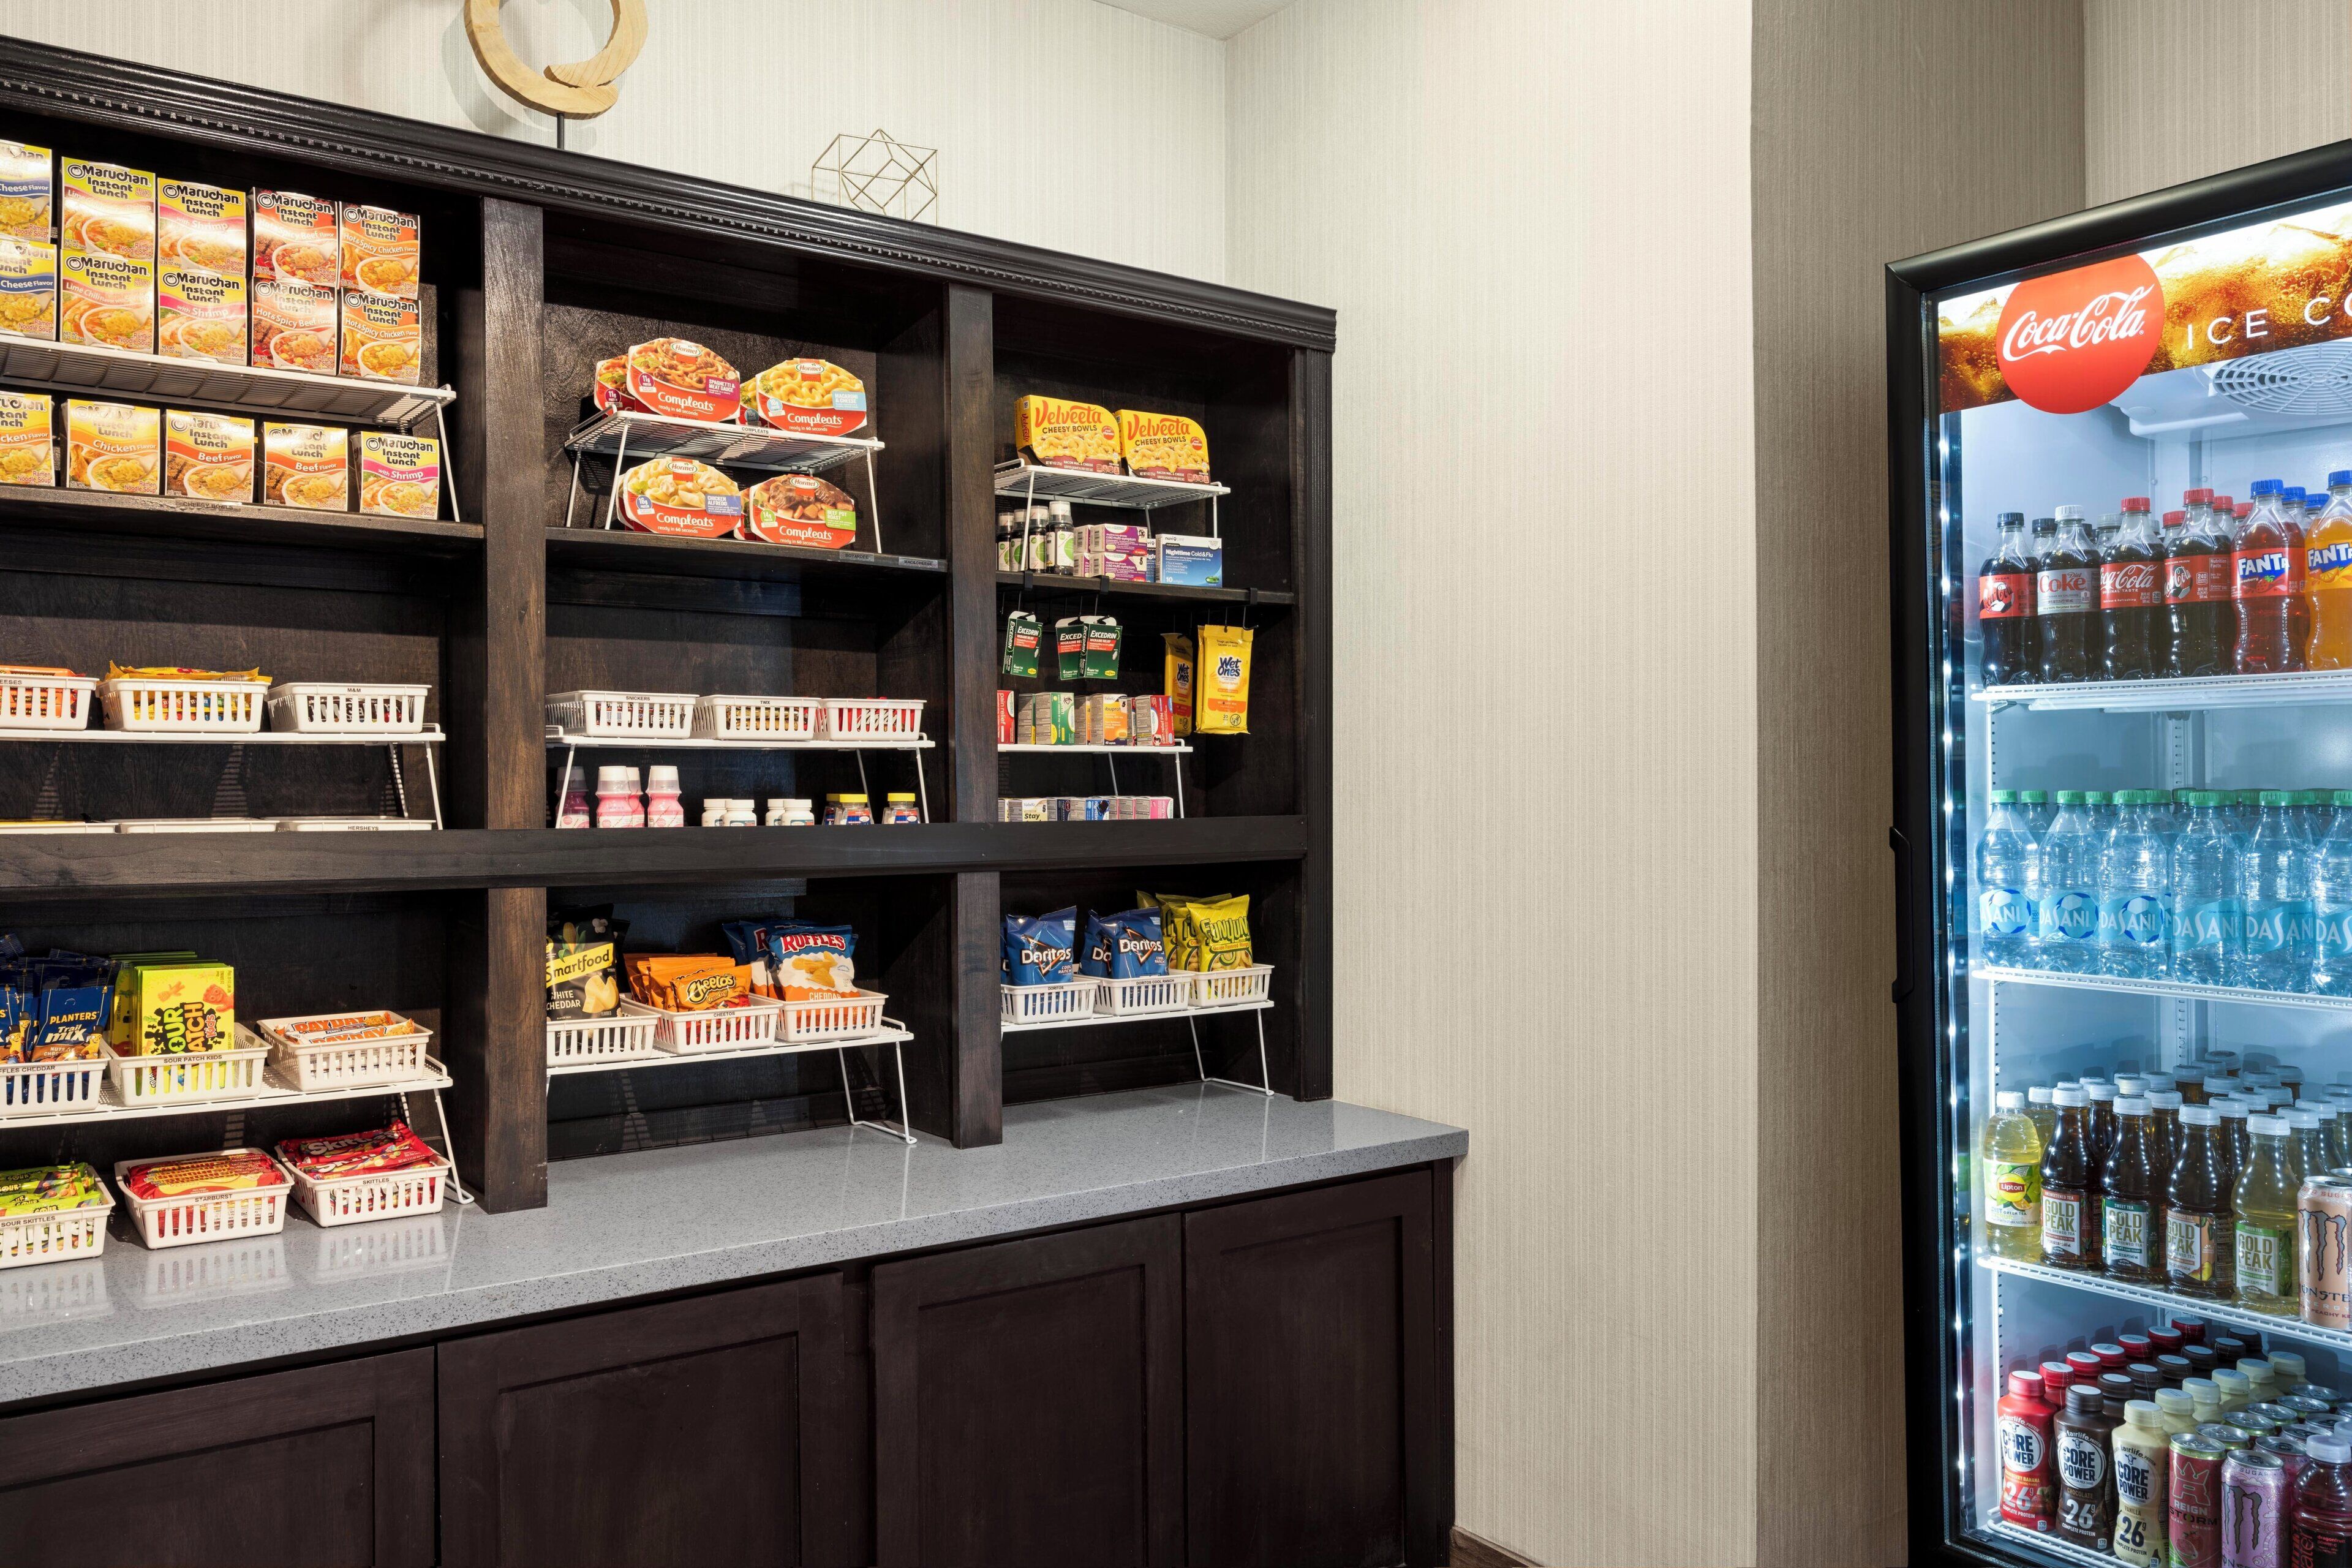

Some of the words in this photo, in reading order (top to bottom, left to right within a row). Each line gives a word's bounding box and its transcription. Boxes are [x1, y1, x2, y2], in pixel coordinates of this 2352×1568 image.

[81, 164, 149, 186] Maruchan
[88, 176, 132, 192] Instant
[92, 186, 128, 199] Lunch
[176, 184, 240, 205] Maruchan
[181, 197, 225, 211] Instant
[186, 205, 220, 217] Lunch
[80, 257, 147, 276] Maruchan
[86, 268, 132, 282] Instant
[176, 273, 240, 290] Maruchan
[91, 277, 127, 290] Lunch
[181, 284, 225, 296] Instant
[186, 292, 220, 304] Lunch
[192, 307, 229, 317] Shrimp
[2002, 284, 2155, 362] Coca-Cola
[2187, 309, 2269, 350] ICE
[674, 345, 698, 355] Hormel
[658, 392, 714, 411] Compleats
[788, 413, 842, 426] Compleats
[1035, 401, 1102, 428] Velveeta
[1128, 414, 1190, 440] Velveeta
[93, 440, 136, 453] Chicken
[198, 452, 222, 462] Beef
[295, 462, 318, 472] Beef
[391, 469, 423, 480] Shrimp
[656, 513, 714, 527] Compleats
[779, 526, 832, 540] Compleats
[2238, 552, 2290, 575] FANTA
[2040, 573, 2087, 594] Coke
[1017, 626, 1039, 636] EXCEDRIN
[1090, 630, 1117, 639] EXCEDRIN
[1178, 663, 1189, 674] Wet
[1219, 657, 1242, 668] Wet
[1177, 673, 1189, 683] Ones
[1218, 666, 1240, 677] Ones
[2040, 904, 2089, 932] DASANI
[2101, 908, 2155, 935] DASANI
[781, 934, 846, 954] RUFFLES
[1119, 939, 1163, 953] Doritos
[1022, 948, 1071, 963] Doritos
[546, 949, 609, 982] Smartfood
[551, 990, 573, 1000] WHITE
[687, 976, 735, 1003] Cheetos
[707, 990, 727, 1003] Crunchy
[546, 1000, 581, 1011] CHEDDAR
[50, 1012, 97, 1025] PLANTERS
[294, 1017, 366, 1032] PAYDAY
[58, 1024, 82, 1033] Trail
[205, 1014, 217, 1038] Kids
[45, 1028, 86, 1043] mix
[195, 1194, 232, 1202] STARBURST
[2045, 1199, 2075, 1218] GOLD
[2045, 1213, 2075, 1232] PEAK
[2109, 1210, 2142, 1228] GOLD
[2109, 1225, 2143, 1243] PEAK
[2238, 1234, 2272, 1254] GOLD
[2238, 1251, 2273, 1270] PEAK
[2002, 1429, 2034, 1452] CORE
[2063, 1447, 2095, 1469] CORE
[2064, 1463, 2095, 1482] POWER
[2117, 1460, 2149, 1487] CORE
[2067, 1487, 2094, 1499] CHOCOLATE
[2119, 1479, 2148, 1500] POWER
[2002, 1505, 2018, 1515] COMPLETE
[2125, 1505, 2141, 1516] VANILLA
[2174, 1499, 2207, 1515] REIGN
[2169, 1506, 2218, 1525] STORM
[2062, 1522, 2079, 1533] COMPLETE
[2116, 1539, 2130, 1551] COMPLETE
